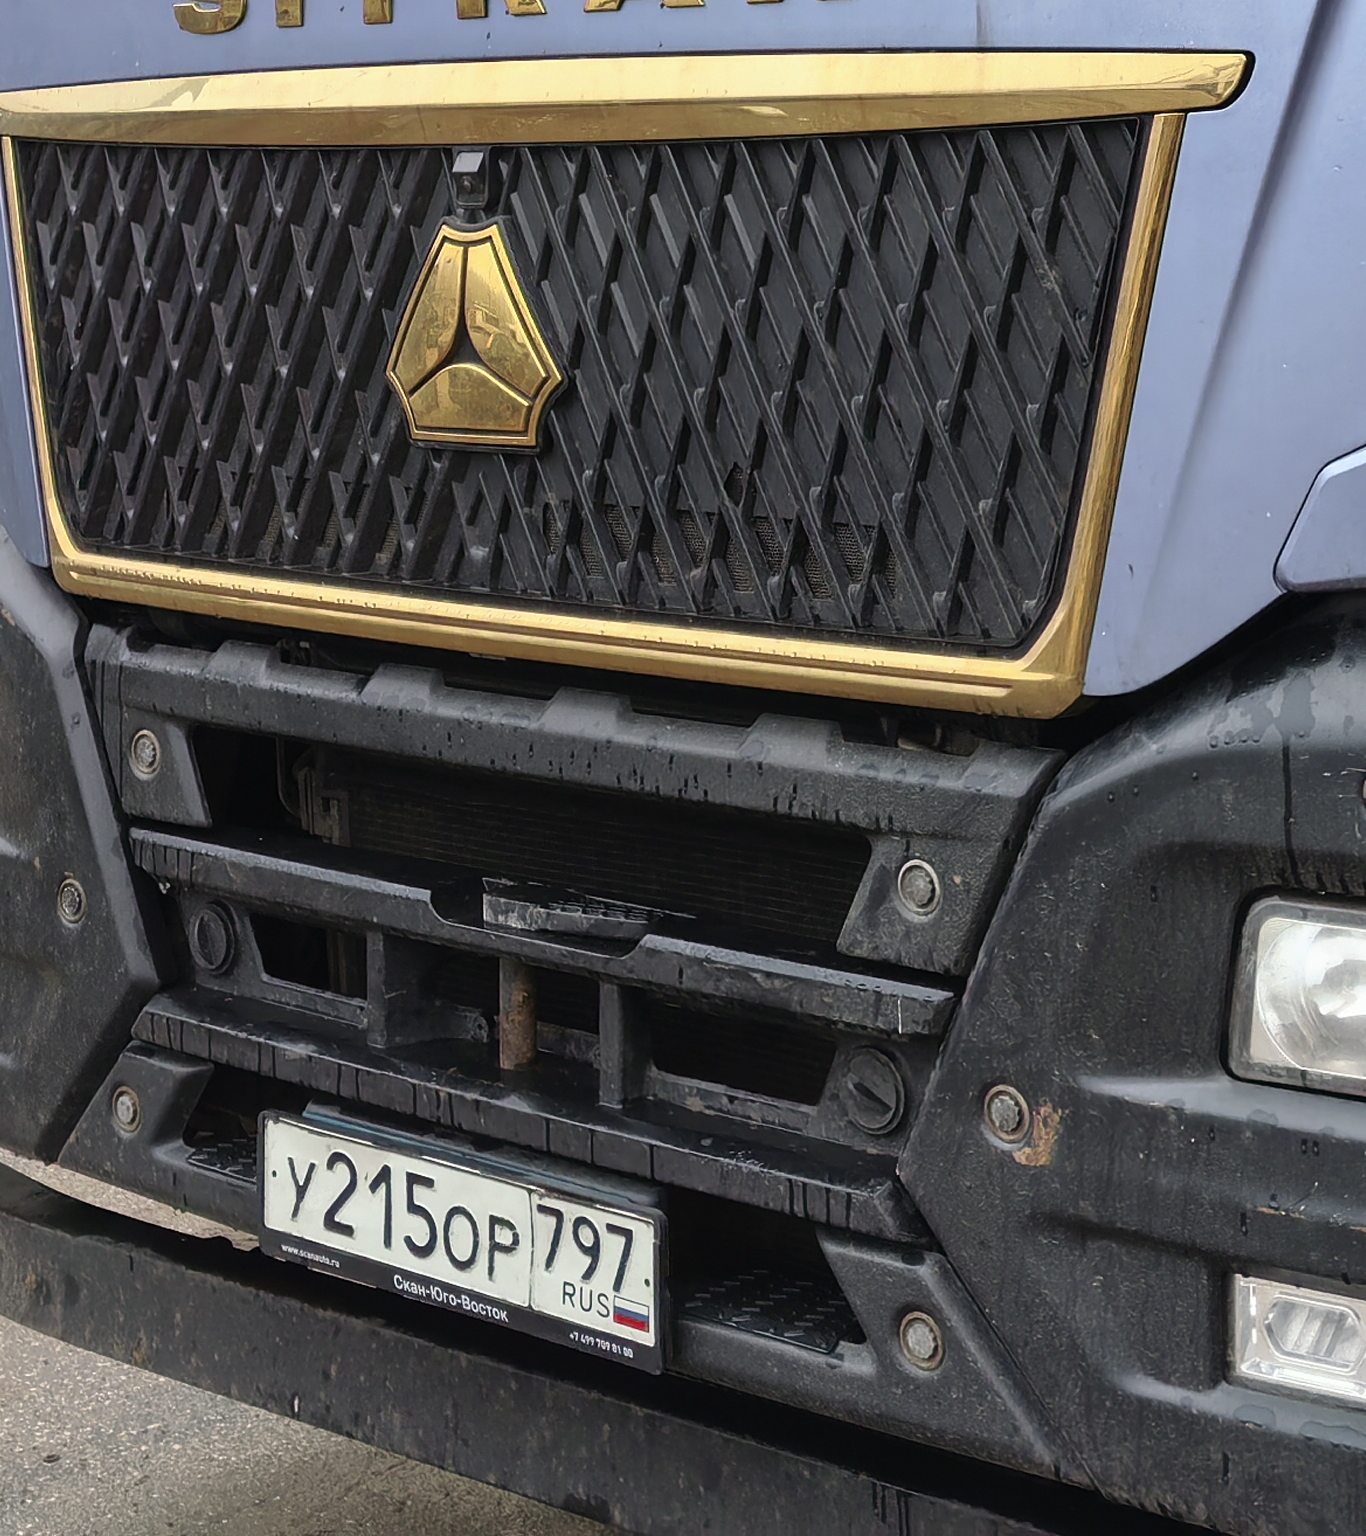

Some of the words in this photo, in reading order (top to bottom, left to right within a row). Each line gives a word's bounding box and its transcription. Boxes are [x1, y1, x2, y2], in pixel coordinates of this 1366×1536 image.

[536, 1204, 635, 1293] 797
[393, 1274, 510, 1323] Скан-Юго-Восток
[561, 1281, 611, 1319] RUS
